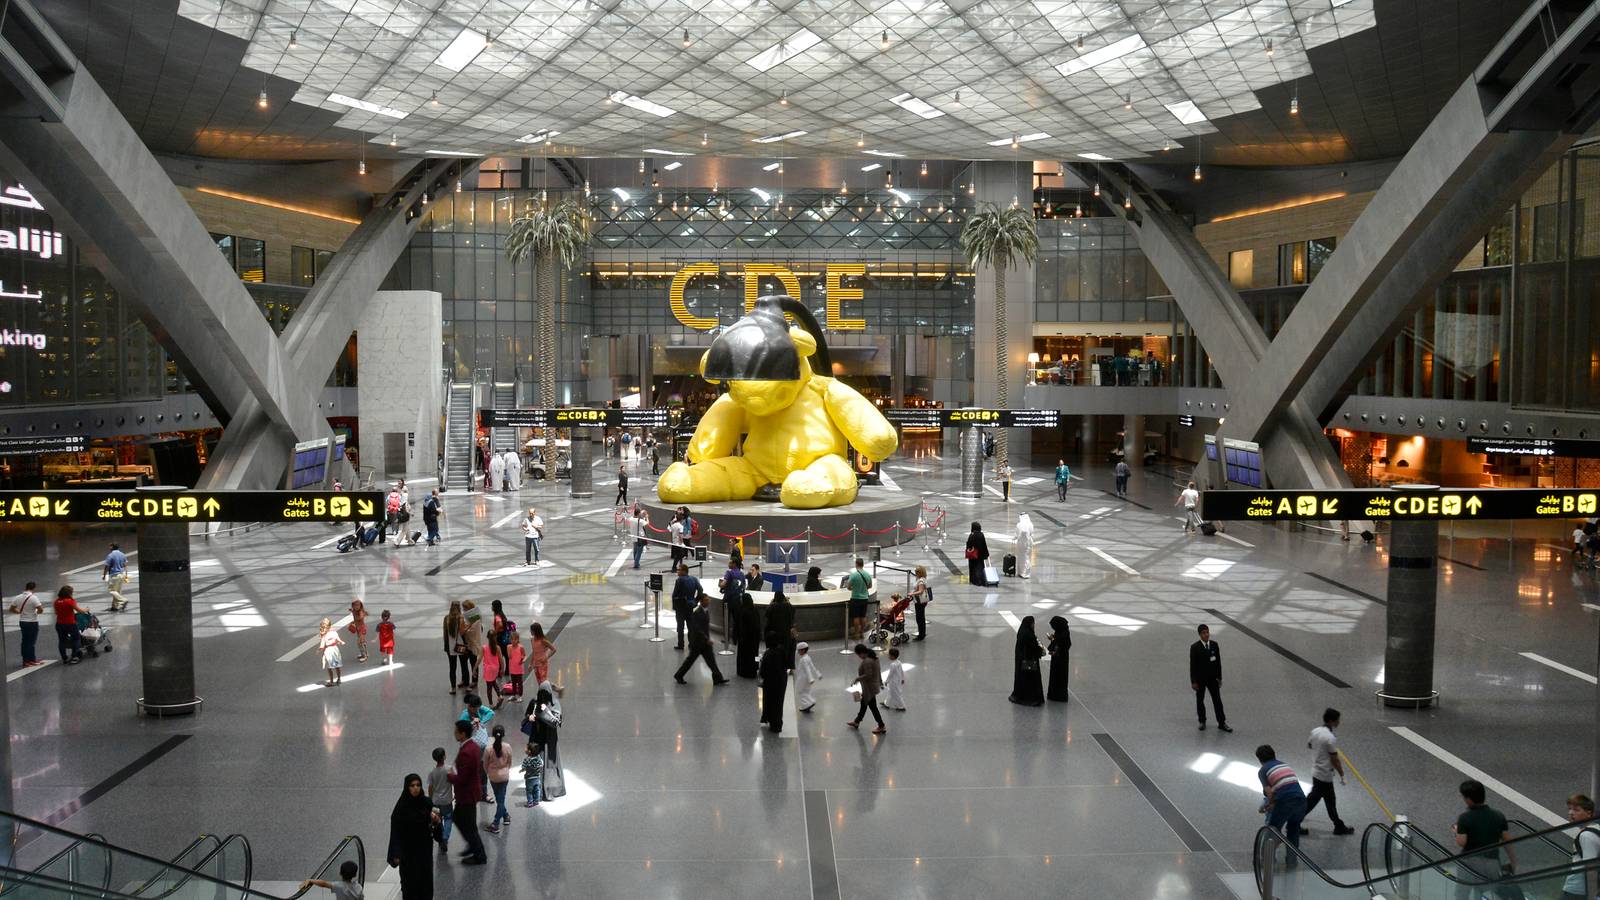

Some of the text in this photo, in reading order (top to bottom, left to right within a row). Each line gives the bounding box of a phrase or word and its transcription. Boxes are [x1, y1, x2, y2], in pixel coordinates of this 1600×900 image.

[0, 329, 46, 350] king
[568, 411, 588, 419] CDE
[962, 411, 981, 419] CDE
[10, 498, 26, 515] A
[97, 499, 173, 518] Gates CDE
[283, 498, 326, 517] Gates B
[1247, 497, 1293, 516] Gates A
[1365, 497, 1439, 516] Gates CDE
[1536, 496, 1574, 514] Gates B
